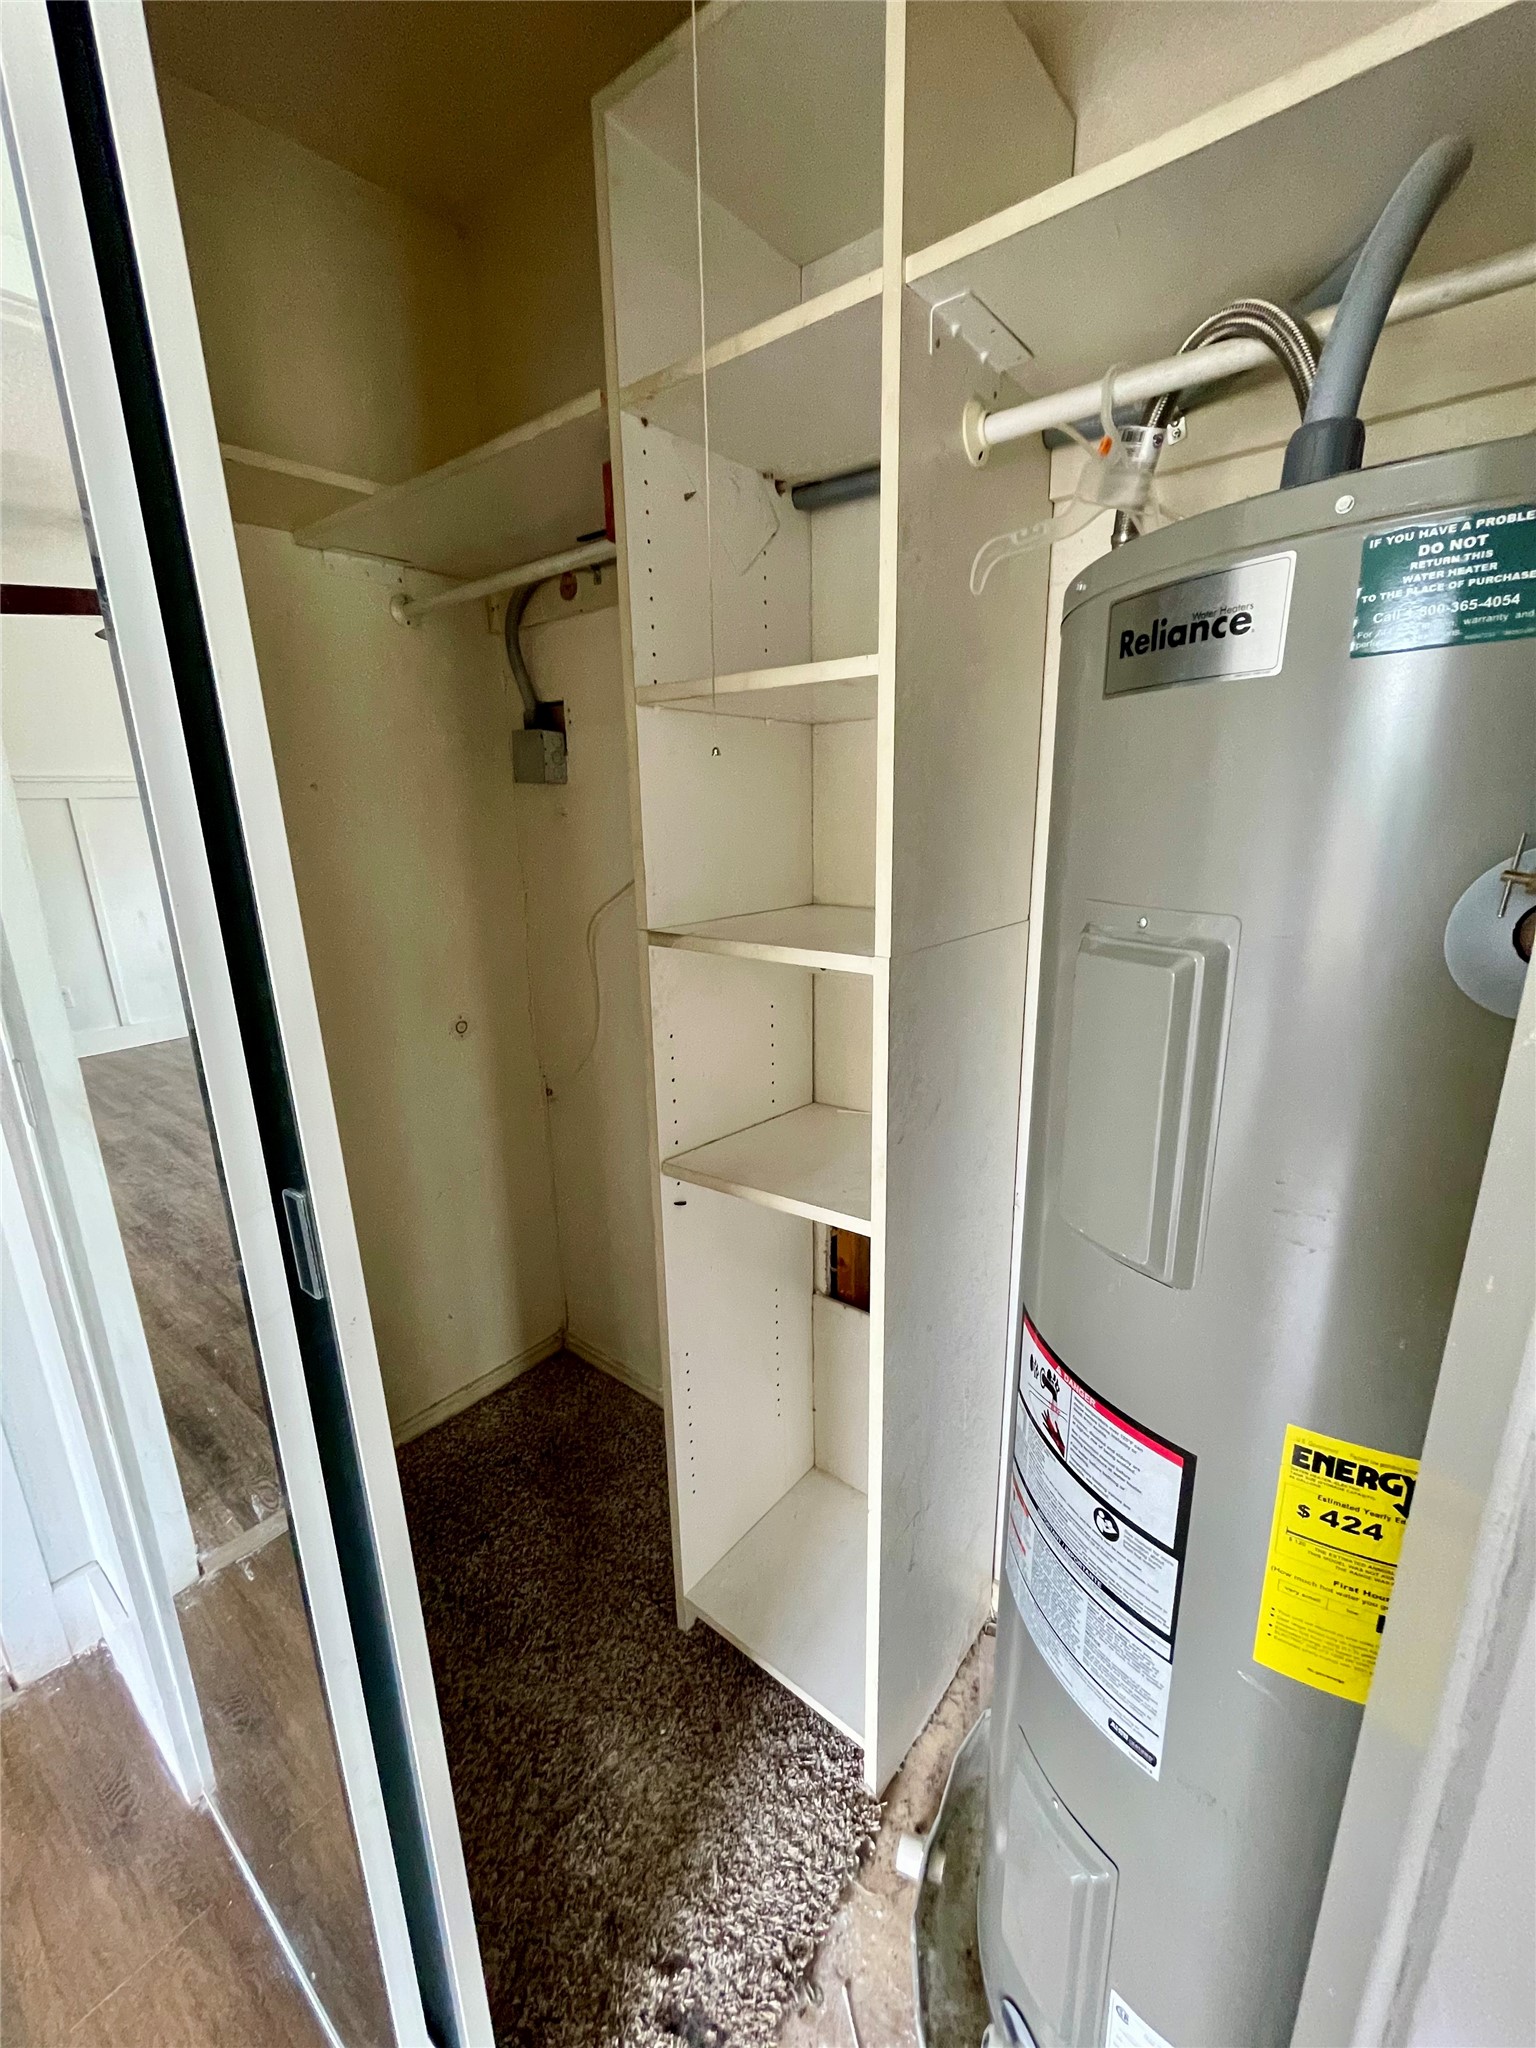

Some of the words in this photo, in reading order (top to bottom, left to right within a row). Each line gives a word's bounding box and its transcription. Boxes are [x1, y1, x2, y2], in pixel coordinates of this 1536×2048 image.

[1369, 538, 1382, 549] IF
[1385, 531, 1415, 546] YOU
[1418, 523, 1458, 539] HAVE
[1460, 521, 1472, 532] A
[1417, 541, 1445, 557] DO
[1449, 533, 1490, 551] NOT
[1409, 554, 1461, 571] RETURN
[1464, 549, 1494, 562] THIS
[1402, 569, 1445, 585] WATER
[1447, 561, 1498, 578] HEATER
[1360, 594, 1377, 604] TO
[1379, 588, 1403, 601] THE
[1405, 582, 1445, 598] PLACE
[1448, 579, 1465, 590] OF
[1467, 569, 1536, 588] PURCHASE
[1191, 608, 1217, 621] Water
[1219, 602, 1254, 616] Heaters
[1372, 609, 1401, 625] Call
[1462, 612, 1509, 626] warranty
[1514, 609, 1536, 620] and
[1119, 611, 1253, 660] Reliance
[1063, 1372, 1096, 1408] DANGER
[1317, 1494, 1361, 1513] Estimated
[1363, 1508, 1392, 1522] Yearly
[1297, 1504, 1311, 1519] $
[1319, 1510, 1384, 1541] 424
[1332, 1580, 1360, 1594] First
